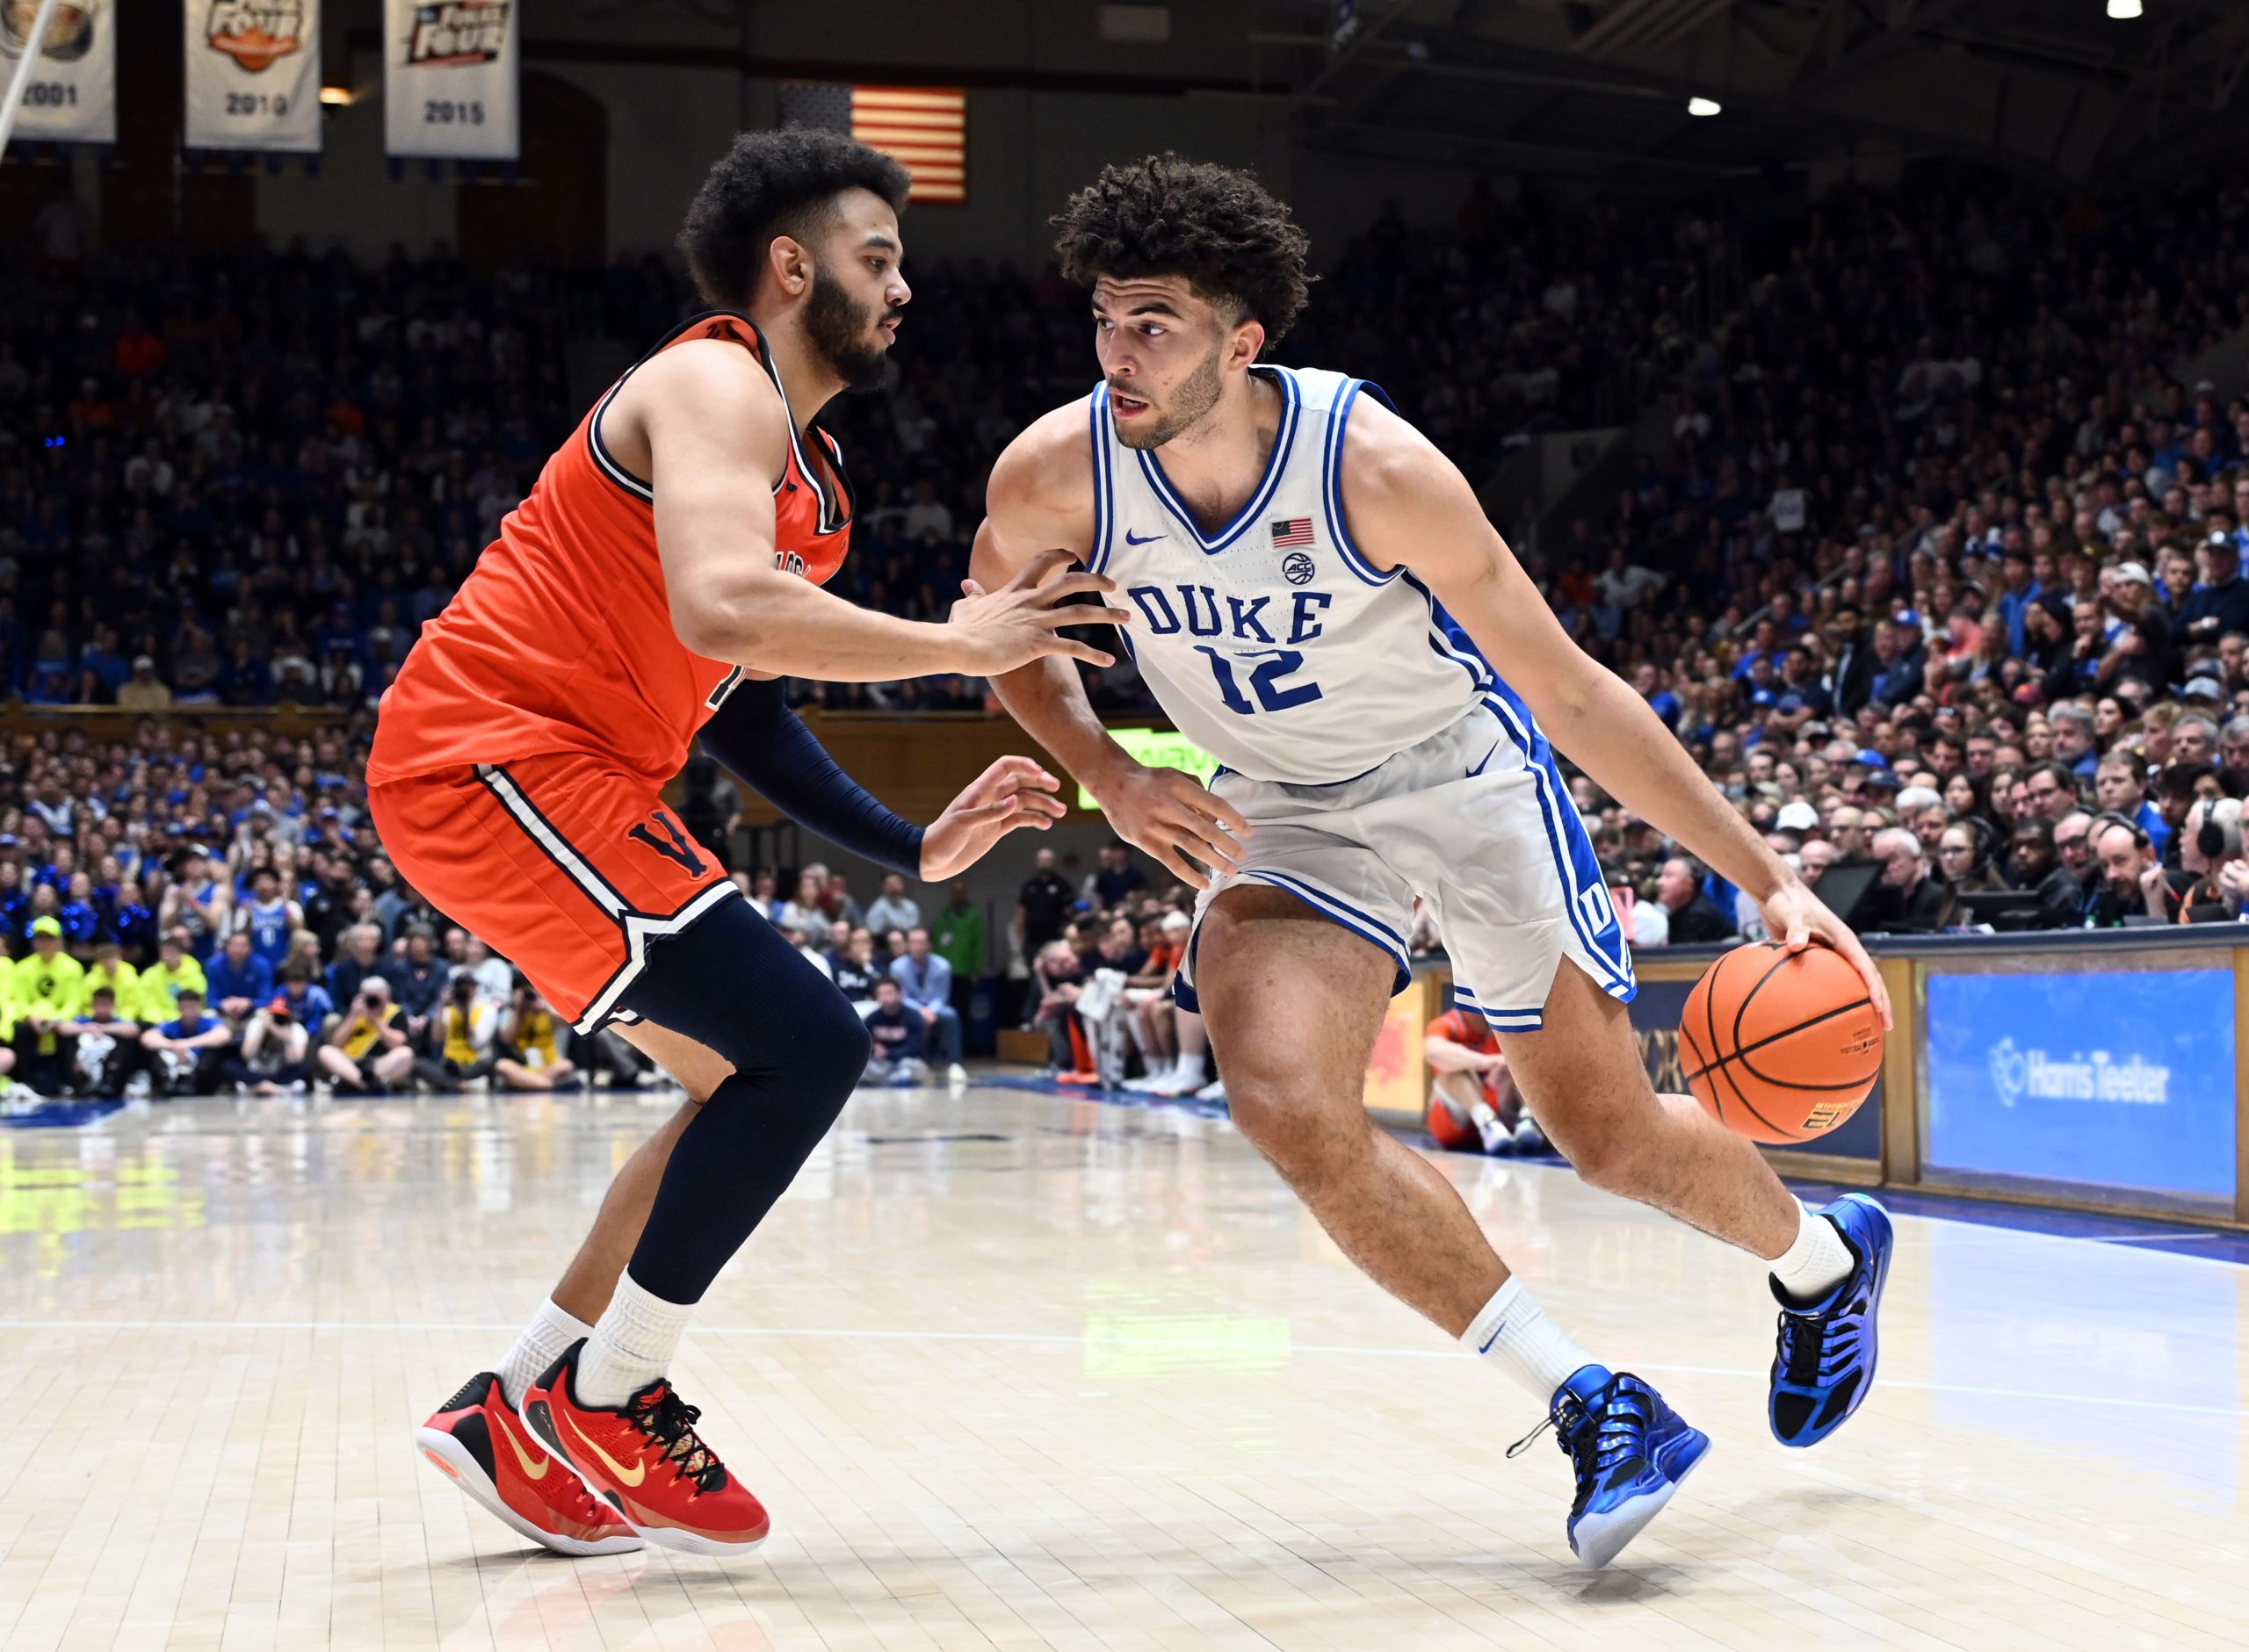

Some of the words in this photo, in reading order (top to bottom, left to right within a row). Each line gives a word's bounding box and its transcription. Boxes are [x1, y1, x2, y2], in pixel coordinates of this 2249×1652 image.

[227, 92, 288, 116] 2010
[425, 99, 485, 125] 2015
[1287, 562, 1312, 573] ACC
[1127, 585, 1332, 645] DUKE
[1193, 645, 1323, 715] 12
[627, 811, 707, 877] V
[1578, 882, 1612, 936] D
[2026, 1050, 2093, 1100] Harris
[2090, 1051, 2169, 1104] Teeter
